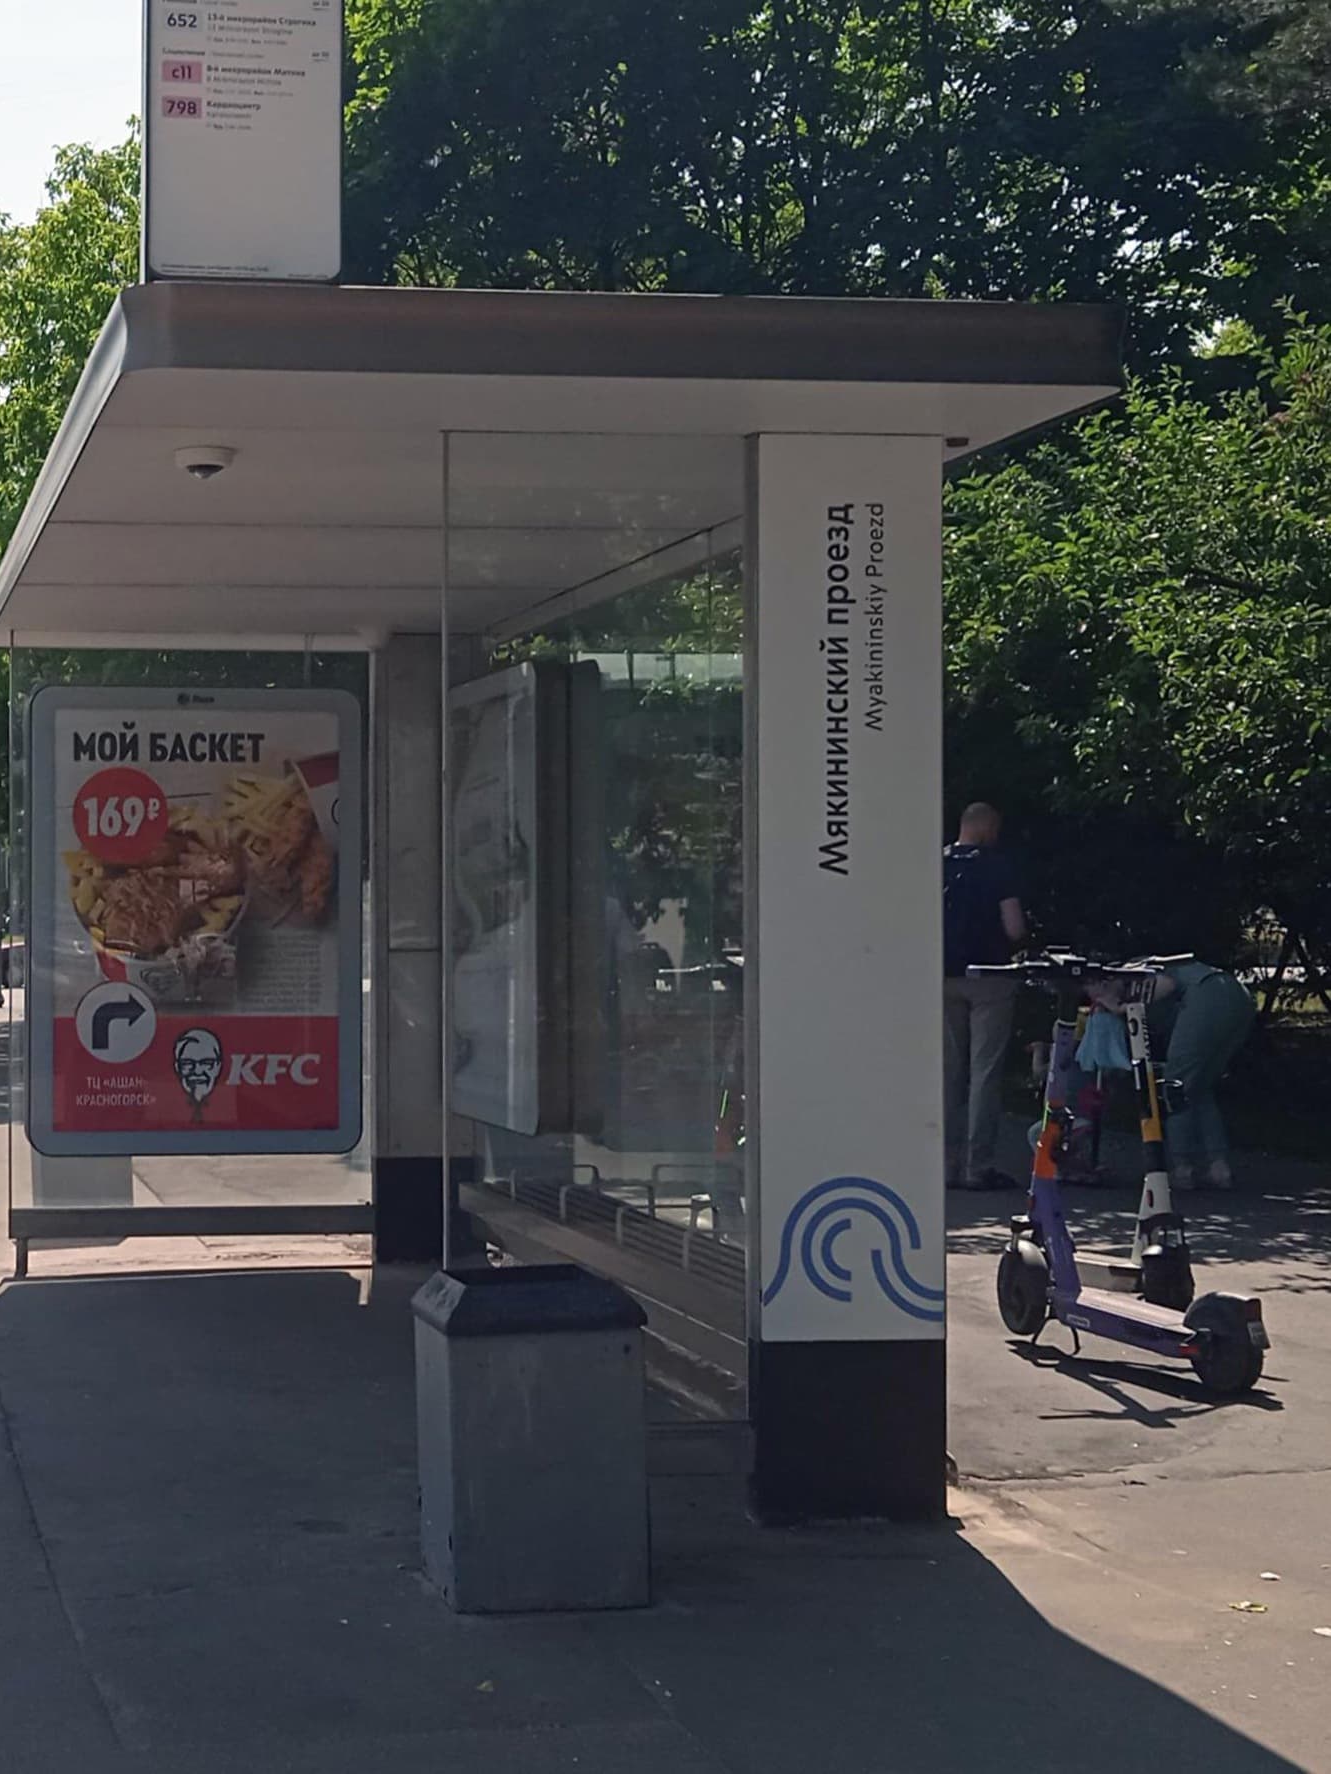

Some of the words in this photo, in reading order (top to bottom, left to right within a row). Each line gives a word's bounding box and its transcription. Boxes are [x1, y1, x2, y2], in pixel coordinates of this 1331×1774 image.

[167, 13, 197, 28] 652
[167, 100, 197, 115] 798
[864, 503, 885, 576] Proezd
[827, 503, 857, 625] проезд
[864, 584, 887, 732] Myakininskiy
[73, 721, 139, 762] МОЙ
[149, 732, 265, 763] БАСКЕТ
[818, 636, 849, 876] Мякининский
[86, 1075, 101, 1090] ТЦ
[226, 1053, 321, 1086] KFC
